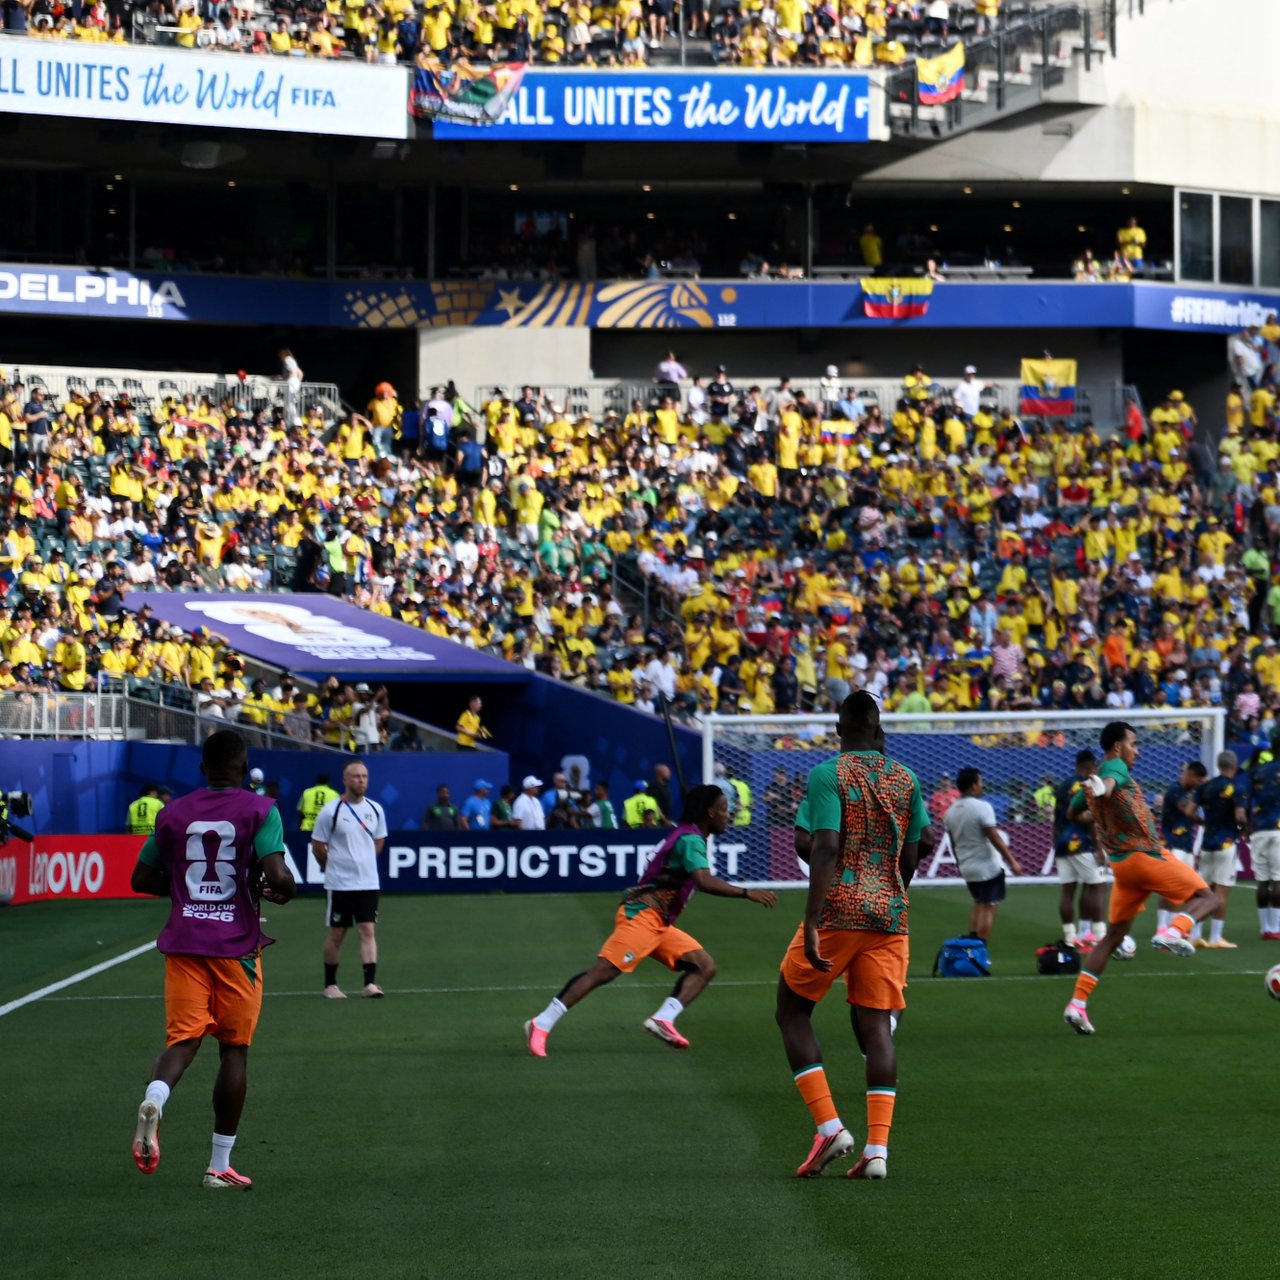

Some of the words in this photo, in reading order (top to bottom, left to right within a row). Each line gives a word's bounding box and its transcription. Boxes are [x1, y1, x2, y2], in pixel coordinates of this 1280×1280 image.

[0, 57, 24, 95] LL
[36, 59, 129, 102] UNITES
[139, 63, 189, 106] the
[196, 68, 284, 119] World
[291, 88, 336, 107] FIFA
[564, 86, 671, 125] UNITES
[679, 81, 739, 129] the
[746, 83, 850, 133] World
[388, 844, 747, 879] PREDICTSTT
[199, 885, 222, 894] FIFA
